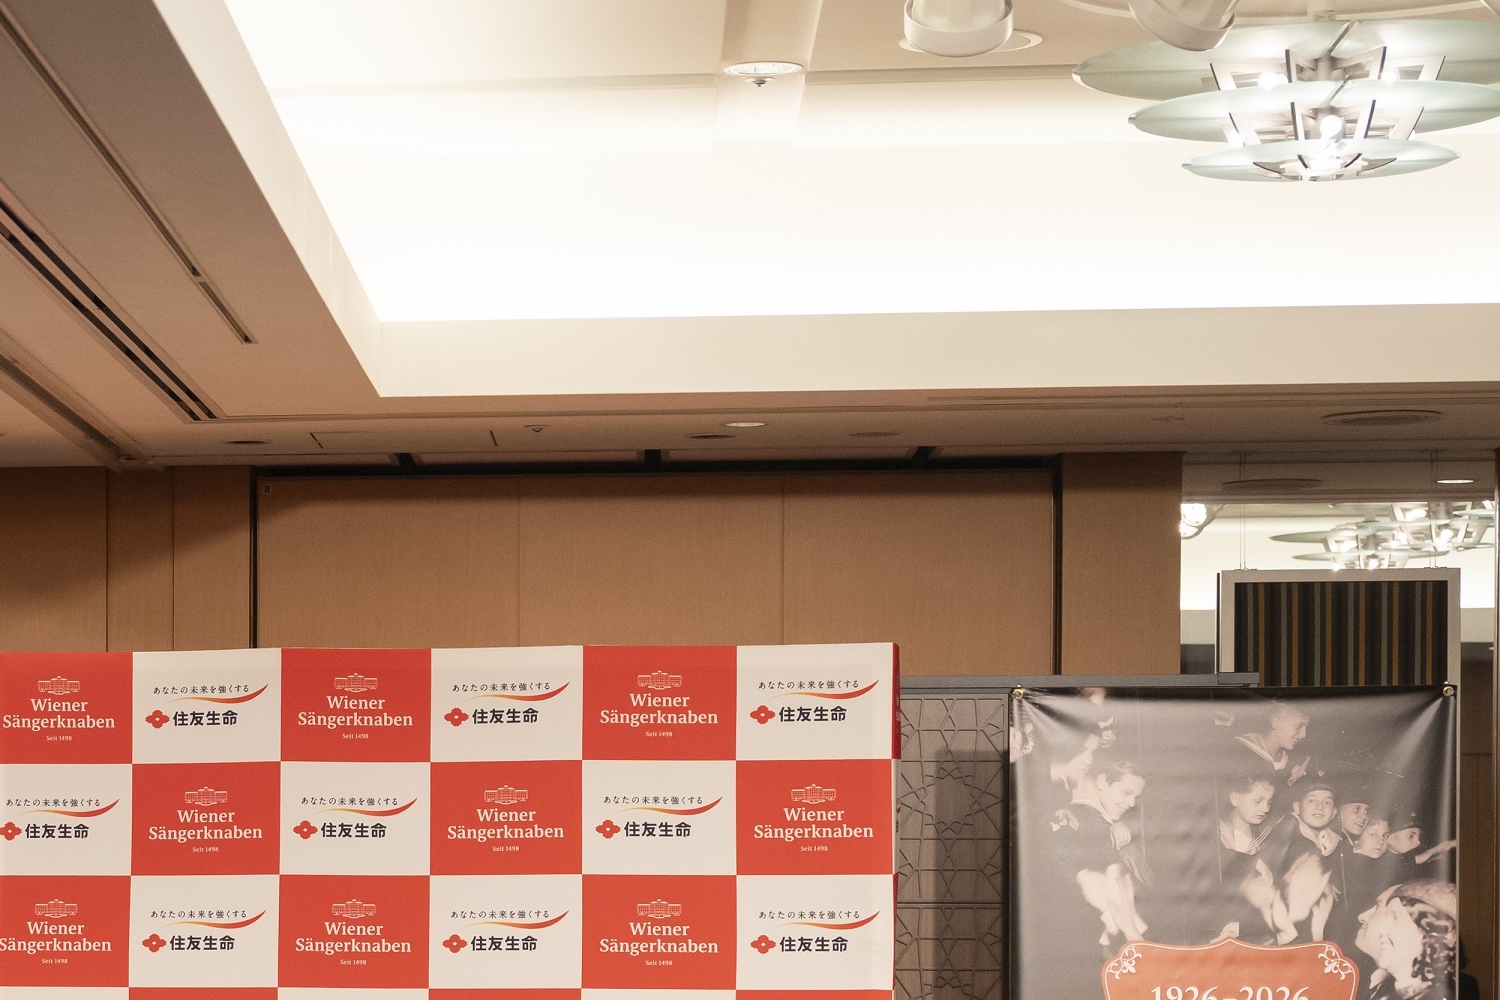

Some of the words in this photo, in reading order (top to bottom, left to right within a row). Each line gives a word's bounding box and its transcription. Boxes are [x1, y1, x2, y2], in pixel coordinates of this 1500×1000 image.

[452, 682, 550, 692] あなたの未来を強くする
[30, 698, 88, 712] Wiener
[326, 695, 386, 710] Wiener
[629, 692, 690, 708] Wiener
[172, 709, 238, 727] 住友生命
[298, 711, 413, 730] Sängerknaben
[471, 707, 539, 725] 住友生命
[600, 709, 719, 728] Sängerknaben
[778, 705, 847, 723] 住友生命
[2, 714, 115, 732] Sängerknaben
[6, 798, 101, 807] あなたの未来を強くする
[604, 795, 702, 805] あなたの未来を強くする
[177, 809, 236, 823] Wiener
[476, 807, 537, 822] Wiener
[783, 806, 845, 822] Wiener
[24, 823, 90, 839] 住友生命
[148, 825, 263, 844] Sängerknaben
[320, 821, 387, 839] 住友生命
[447, 823, 565, 843] Sängerknaben
[623, 821, 692, 838] 住友生命
[753, 823, 874, 842] Sängerknaben
[759, 910, 860, 920] あなたの未来を強くする
[26, 921, 85, 935] Wiener
[324, 921, 384, 936] Wiener
[628, 921, 690, 937] Wiener
[169, 934, 236, 951] 住友生命
[295, 937, 412, 956] Sängerknaben
[470, 935, 538, 952] 住友生命
[599, 938, 719, 957] Sängerknaben
[779, 936, 849, 953] 住友生命
